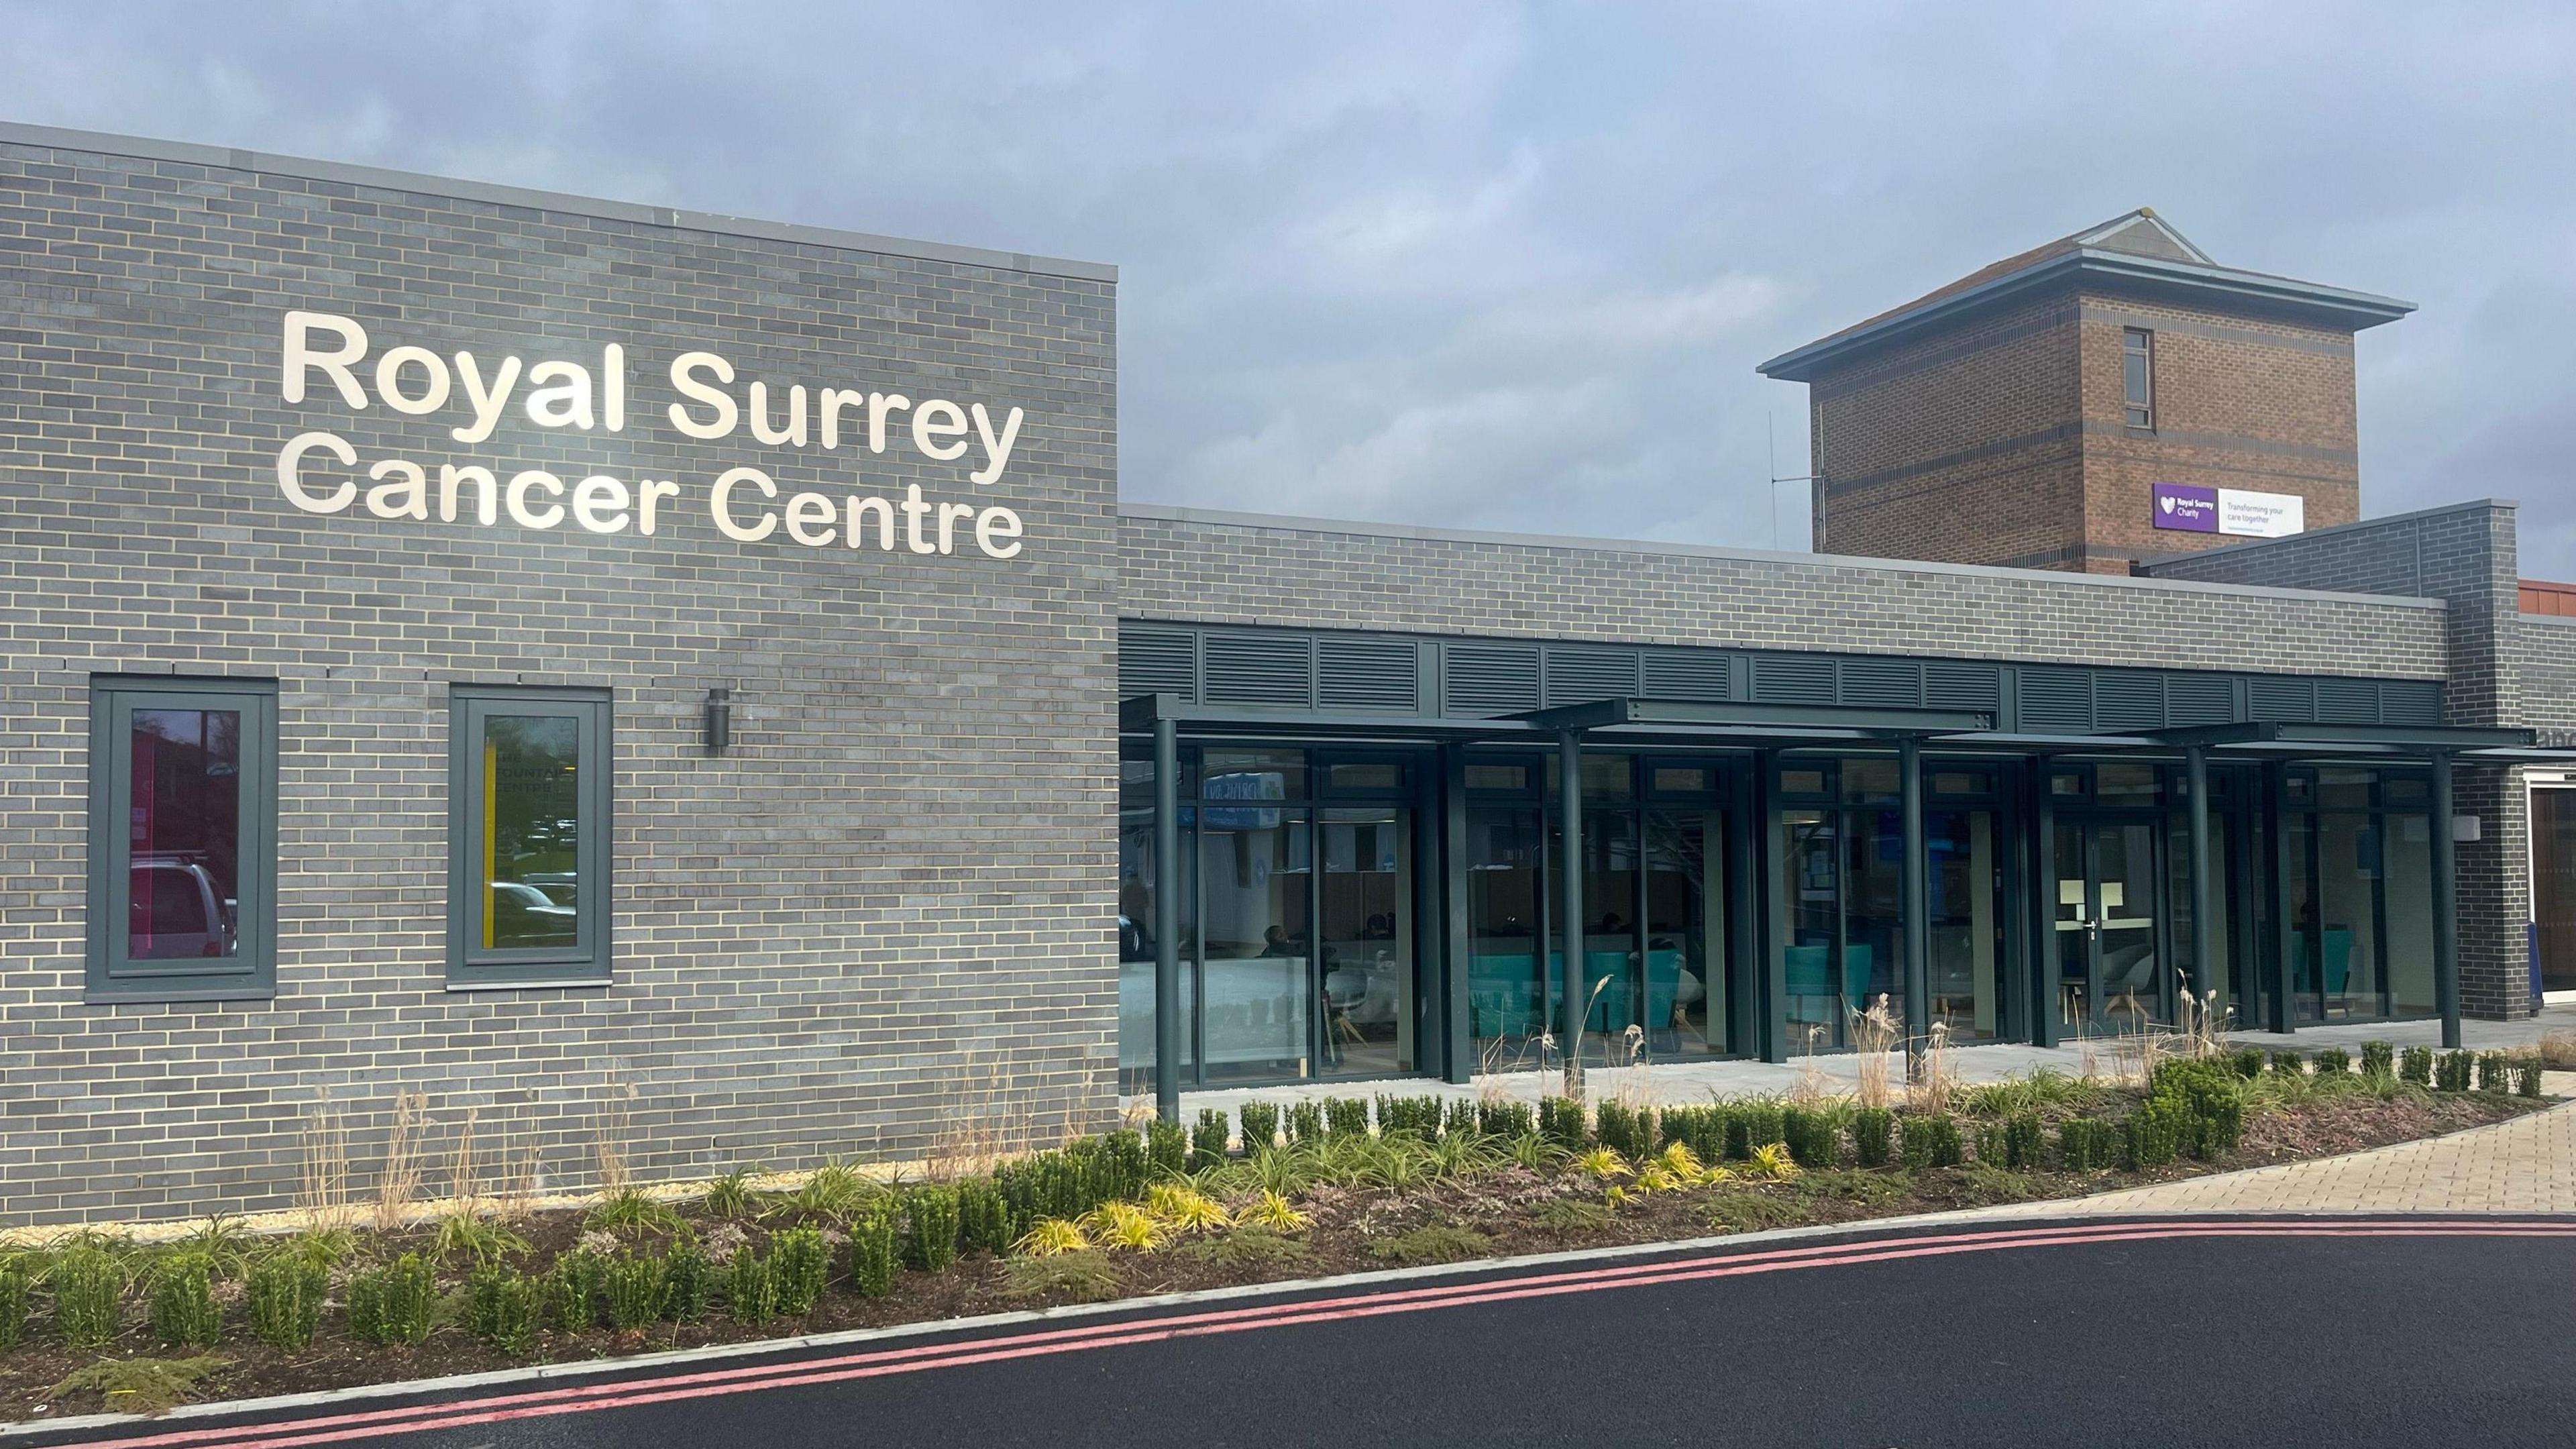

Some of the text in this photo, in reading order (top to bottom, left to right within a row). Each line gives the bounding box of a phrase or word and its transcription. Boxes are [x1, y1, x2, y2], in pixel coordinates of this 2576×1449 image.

[282, 310, 1024, 486] Royal Surrey
[276, 431, 1023, 559] Cancer Centre
[2177, 498, 2214, 511] Royal Surrey
[2227, 502, 2284, 515] Transforming your
[2177, 507, 2199, 520] Charity
[2242, 514, 2269, 524] together
